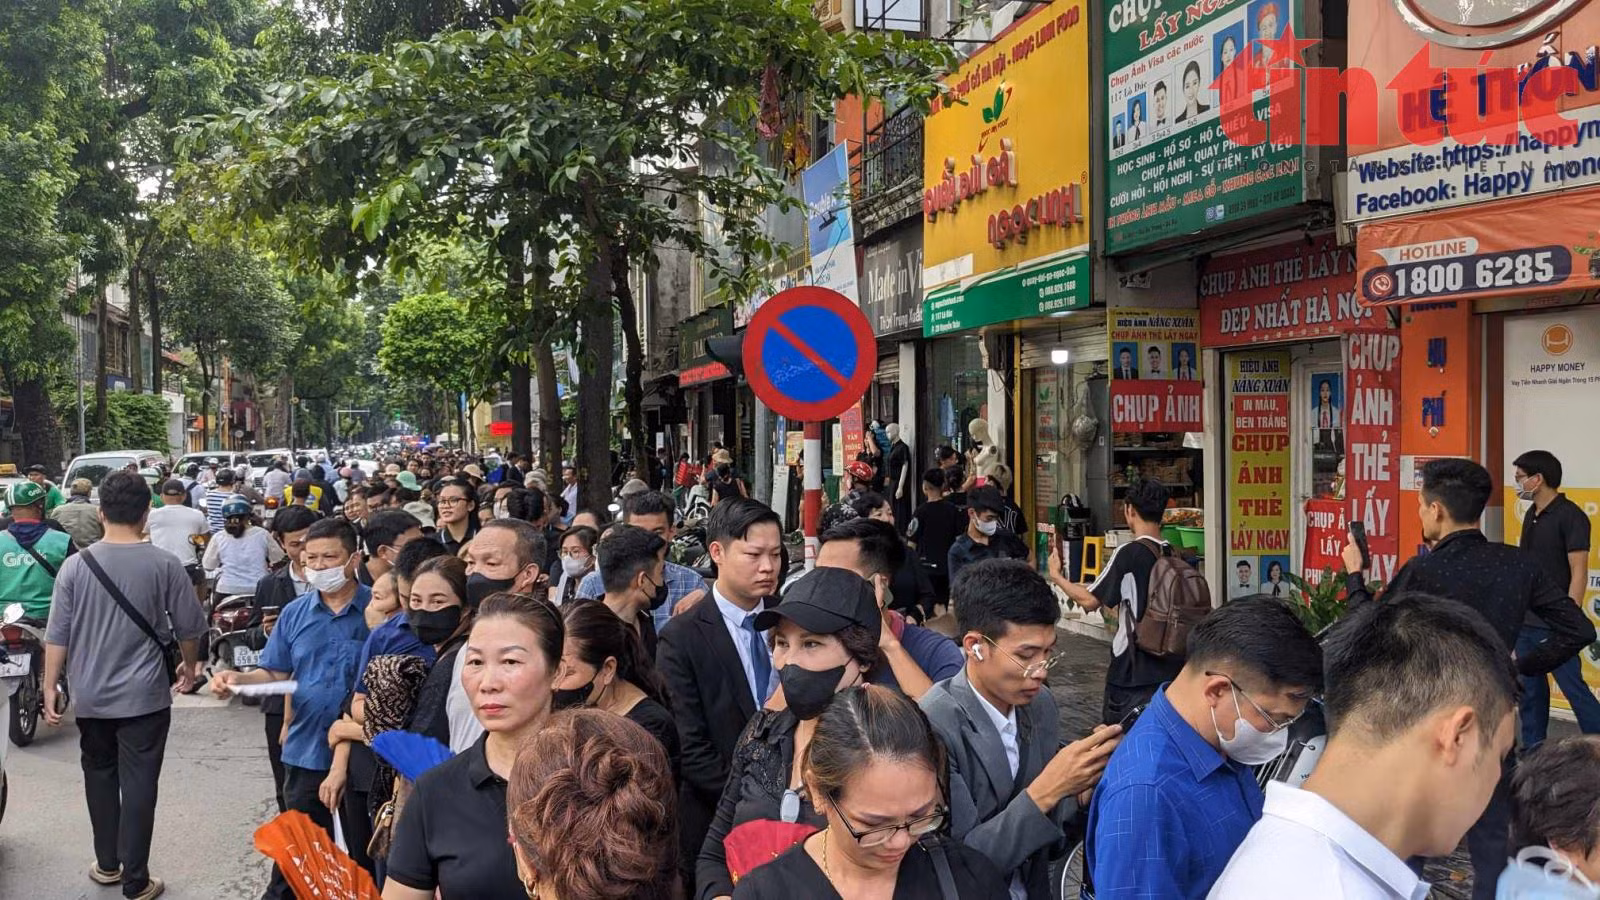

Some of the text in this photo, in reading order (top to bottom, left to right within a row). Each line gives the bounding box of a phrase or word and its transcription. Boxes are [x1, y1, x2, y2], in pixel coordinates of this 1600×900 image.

[1057, 5, 1080, 35] FOOD
[1109, 0, 1162, 33] CHỤ
[1139, 10, 1182, 51] LẤY
[1110, 72, 1129, 88] Chụp
[1131, 63, 1146, 78] Ảnh
[1147, 53, 1165, 70] Visa
[1117, 161, 1134, 176] HỌC
[1136, 154, 1156, 169] SINH
[1163, 138, 1177, 157] HỒ
[1179, 135, 1192, 151] SƠ
[1199, 127, 1214, 144] HỘ
[1257, 102, 1282, 122] VISA
[1141, 133, 1249, 182] CHỤP ẢNH QUAY PHIM
[987, 138, 1018, 188] GÀ
[1131, 182, 1145, 201] HỎI
[1153, 177, 1168, 195] HỘI
[1171, 170, 1193, 188] NGHỊ
[1201, 162, 1214, 178] SỰ
[1357, 156, 1600, 215] Facebook: Happy mon
[988, 198, 1040, 250] NGỌC
[1200, 270, 1235, 298] CHỤP
[1239, 258, 1270, 291] ẢNH
[1274, 247, 1304, 284] THẺ
[1308, 240, 1342, 279] LẤY
[1400, 240, 1467, 261] HOTLINE
[868, 264, 896, 304] Made
[898, 259, 908, 295] in
[1396, 262, 1463, 296] 1800
[1475, 251, 1553, 286] 6285
[1220, 307, 1250, 337] ĐẸP
[1254, 288, 1301, 330] NHẤT
[1305, 288, 1332, 324] HÀ
[1349, 333, 1400, 383] CHỤP
[1530, 362, 1585, 373] HAPPY MONEY
[1113, 384, 1200, 430] CHỤP ẢNH
[1243, 399, 1252, 411] IN
[1351, 374, 1393, 426] ẢNH
[1235, 416, 1255, 428] ĐEN
[1232, 434, 1290, 456] CHỤP
[1351, 430, 1391, 481] THẺ
[1238, 461, 1283, 484] ẢNH
[1238, 491, 1283, 516] THẺ
[1307, 511, 1335, 533] CHỤP
[1231, 522, 1290, 550] LẤY NGAY
[1320, 534, 1341, 557] LẤY
[3, 549, 46, 567] Gra
